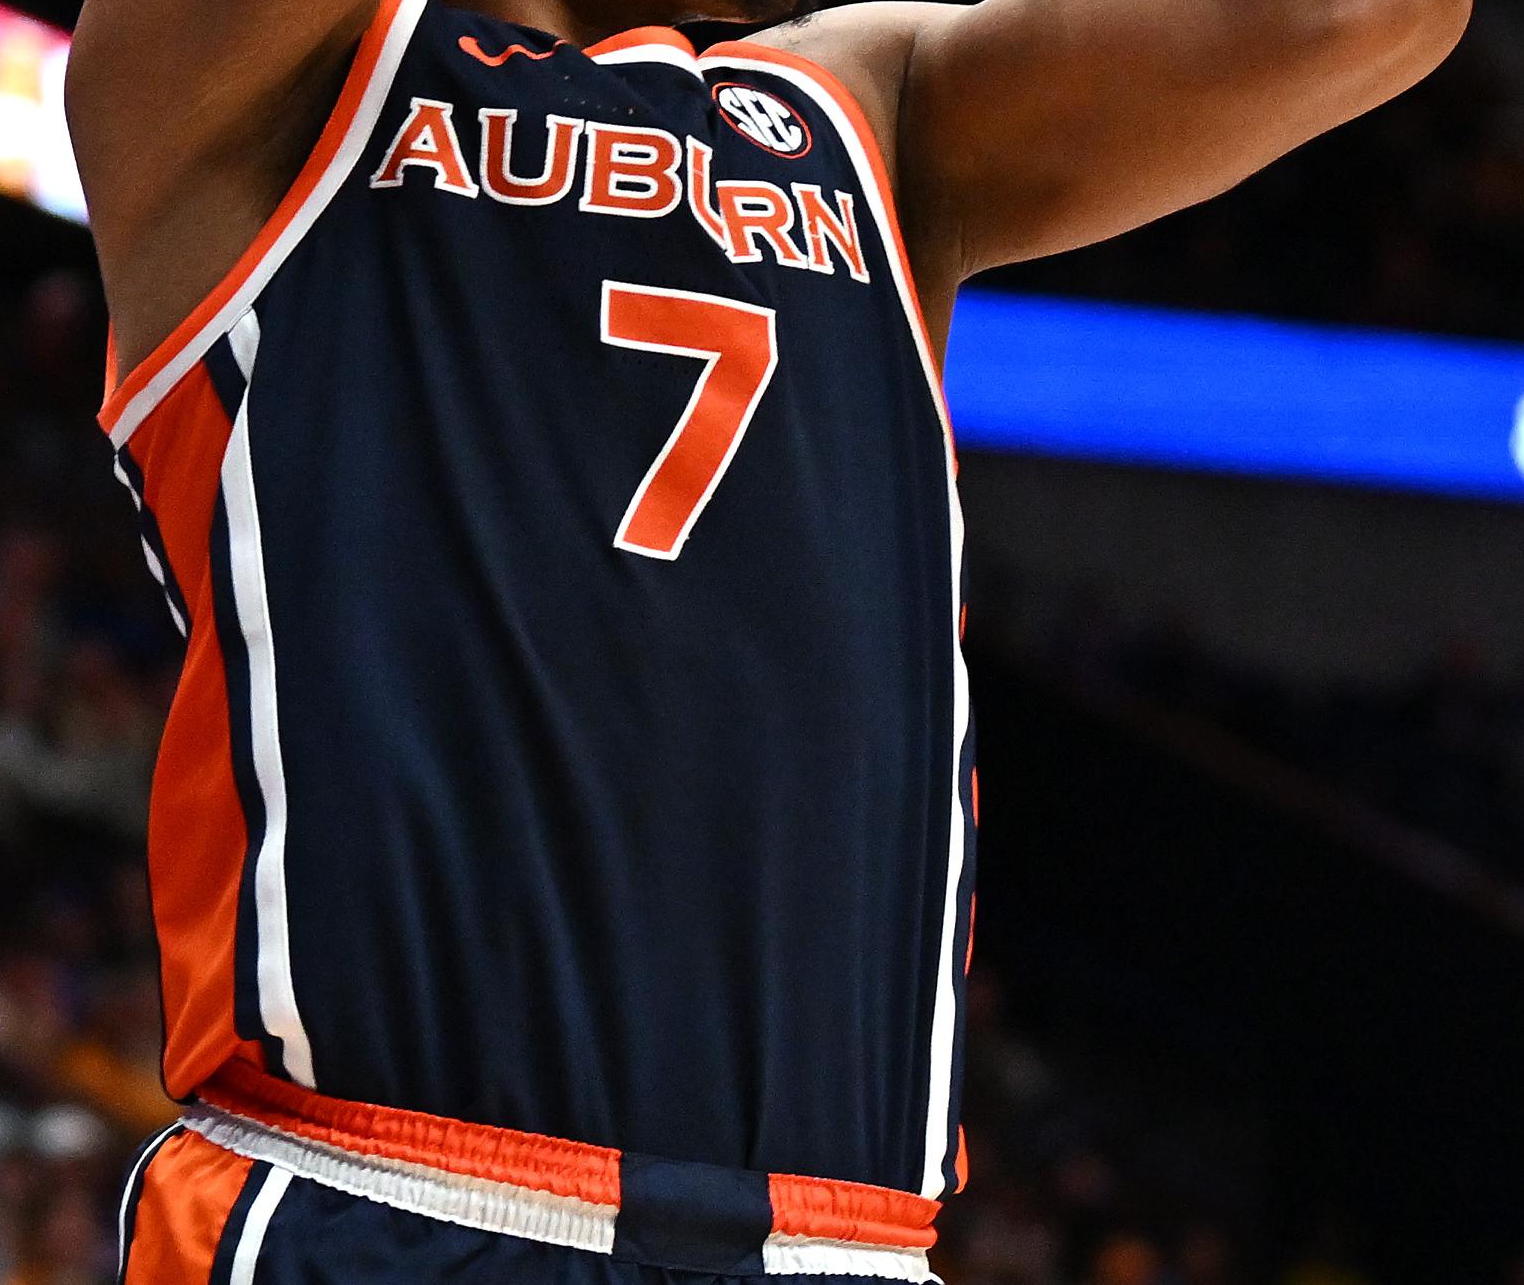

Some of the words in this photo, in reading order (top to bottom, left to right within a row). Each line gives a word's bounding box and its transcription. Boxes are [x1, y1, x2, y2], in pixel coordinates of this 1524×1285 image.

[369, 97, 871, 285] AUBURN
[718, 87, 803, 152] SEC
[600, 279, 779, 562] 7
